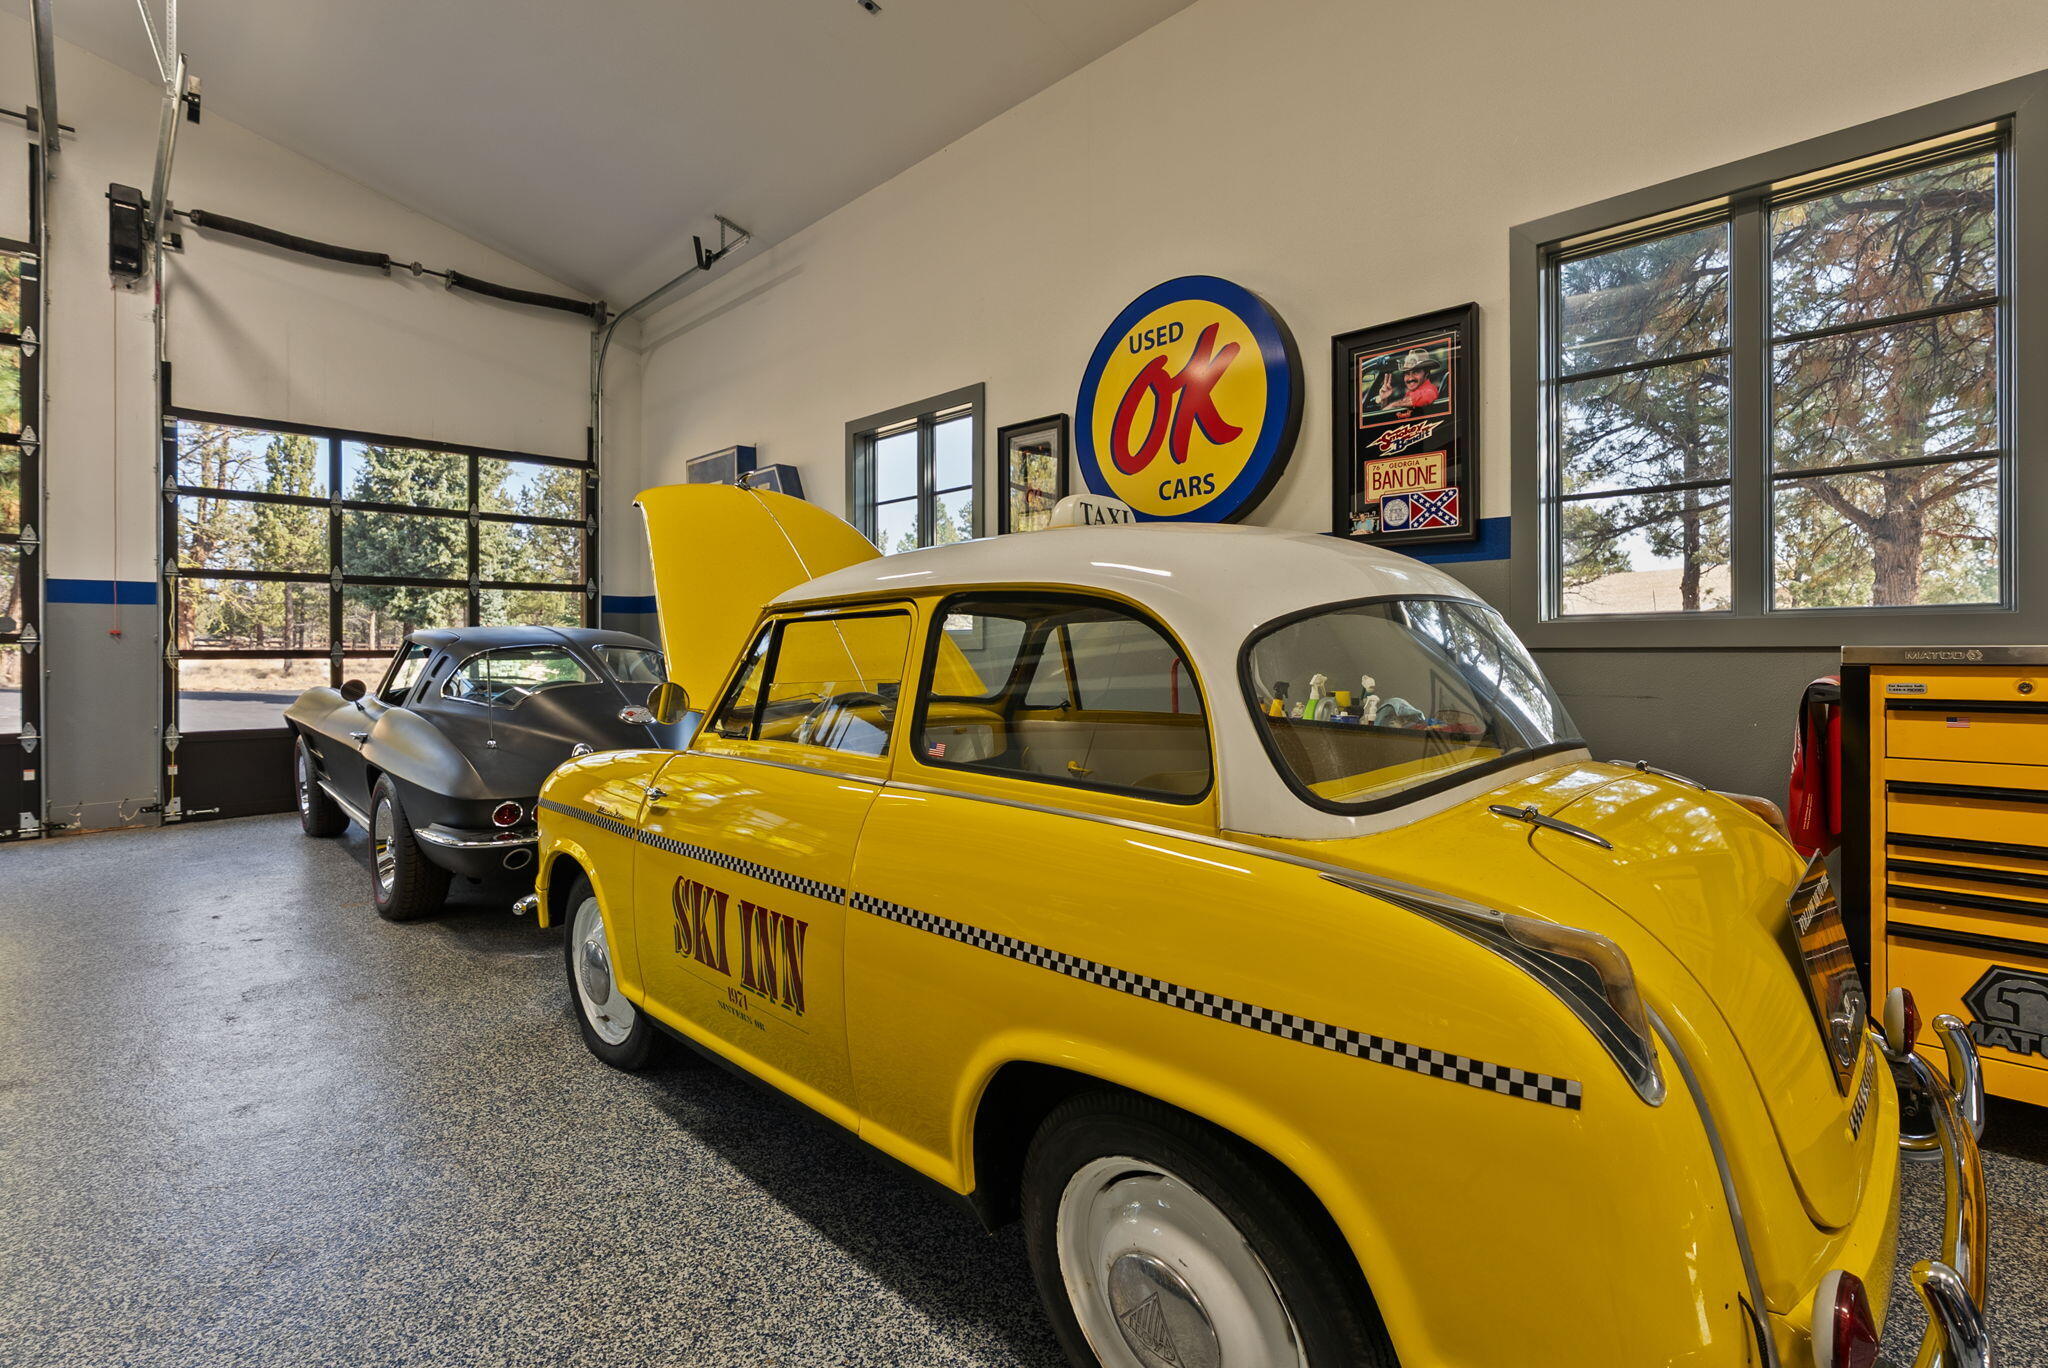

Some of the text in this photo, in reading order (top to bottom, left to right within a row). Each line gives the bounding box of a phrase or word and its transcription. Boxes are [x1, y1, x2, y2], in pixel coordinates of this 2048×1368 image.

[1129, 321, 1184, 354] USED
[1110, 322, 1243, 475] OK
[1372, 465, 1437, 491] BAN ONE
[1388, 460, 1420, 469] GEORGIA
[1158, 473, 1216, 501] CARS
[1080, 502, 1129, 525] TAXI
[672, 875, 808, 1017] SKI INN
